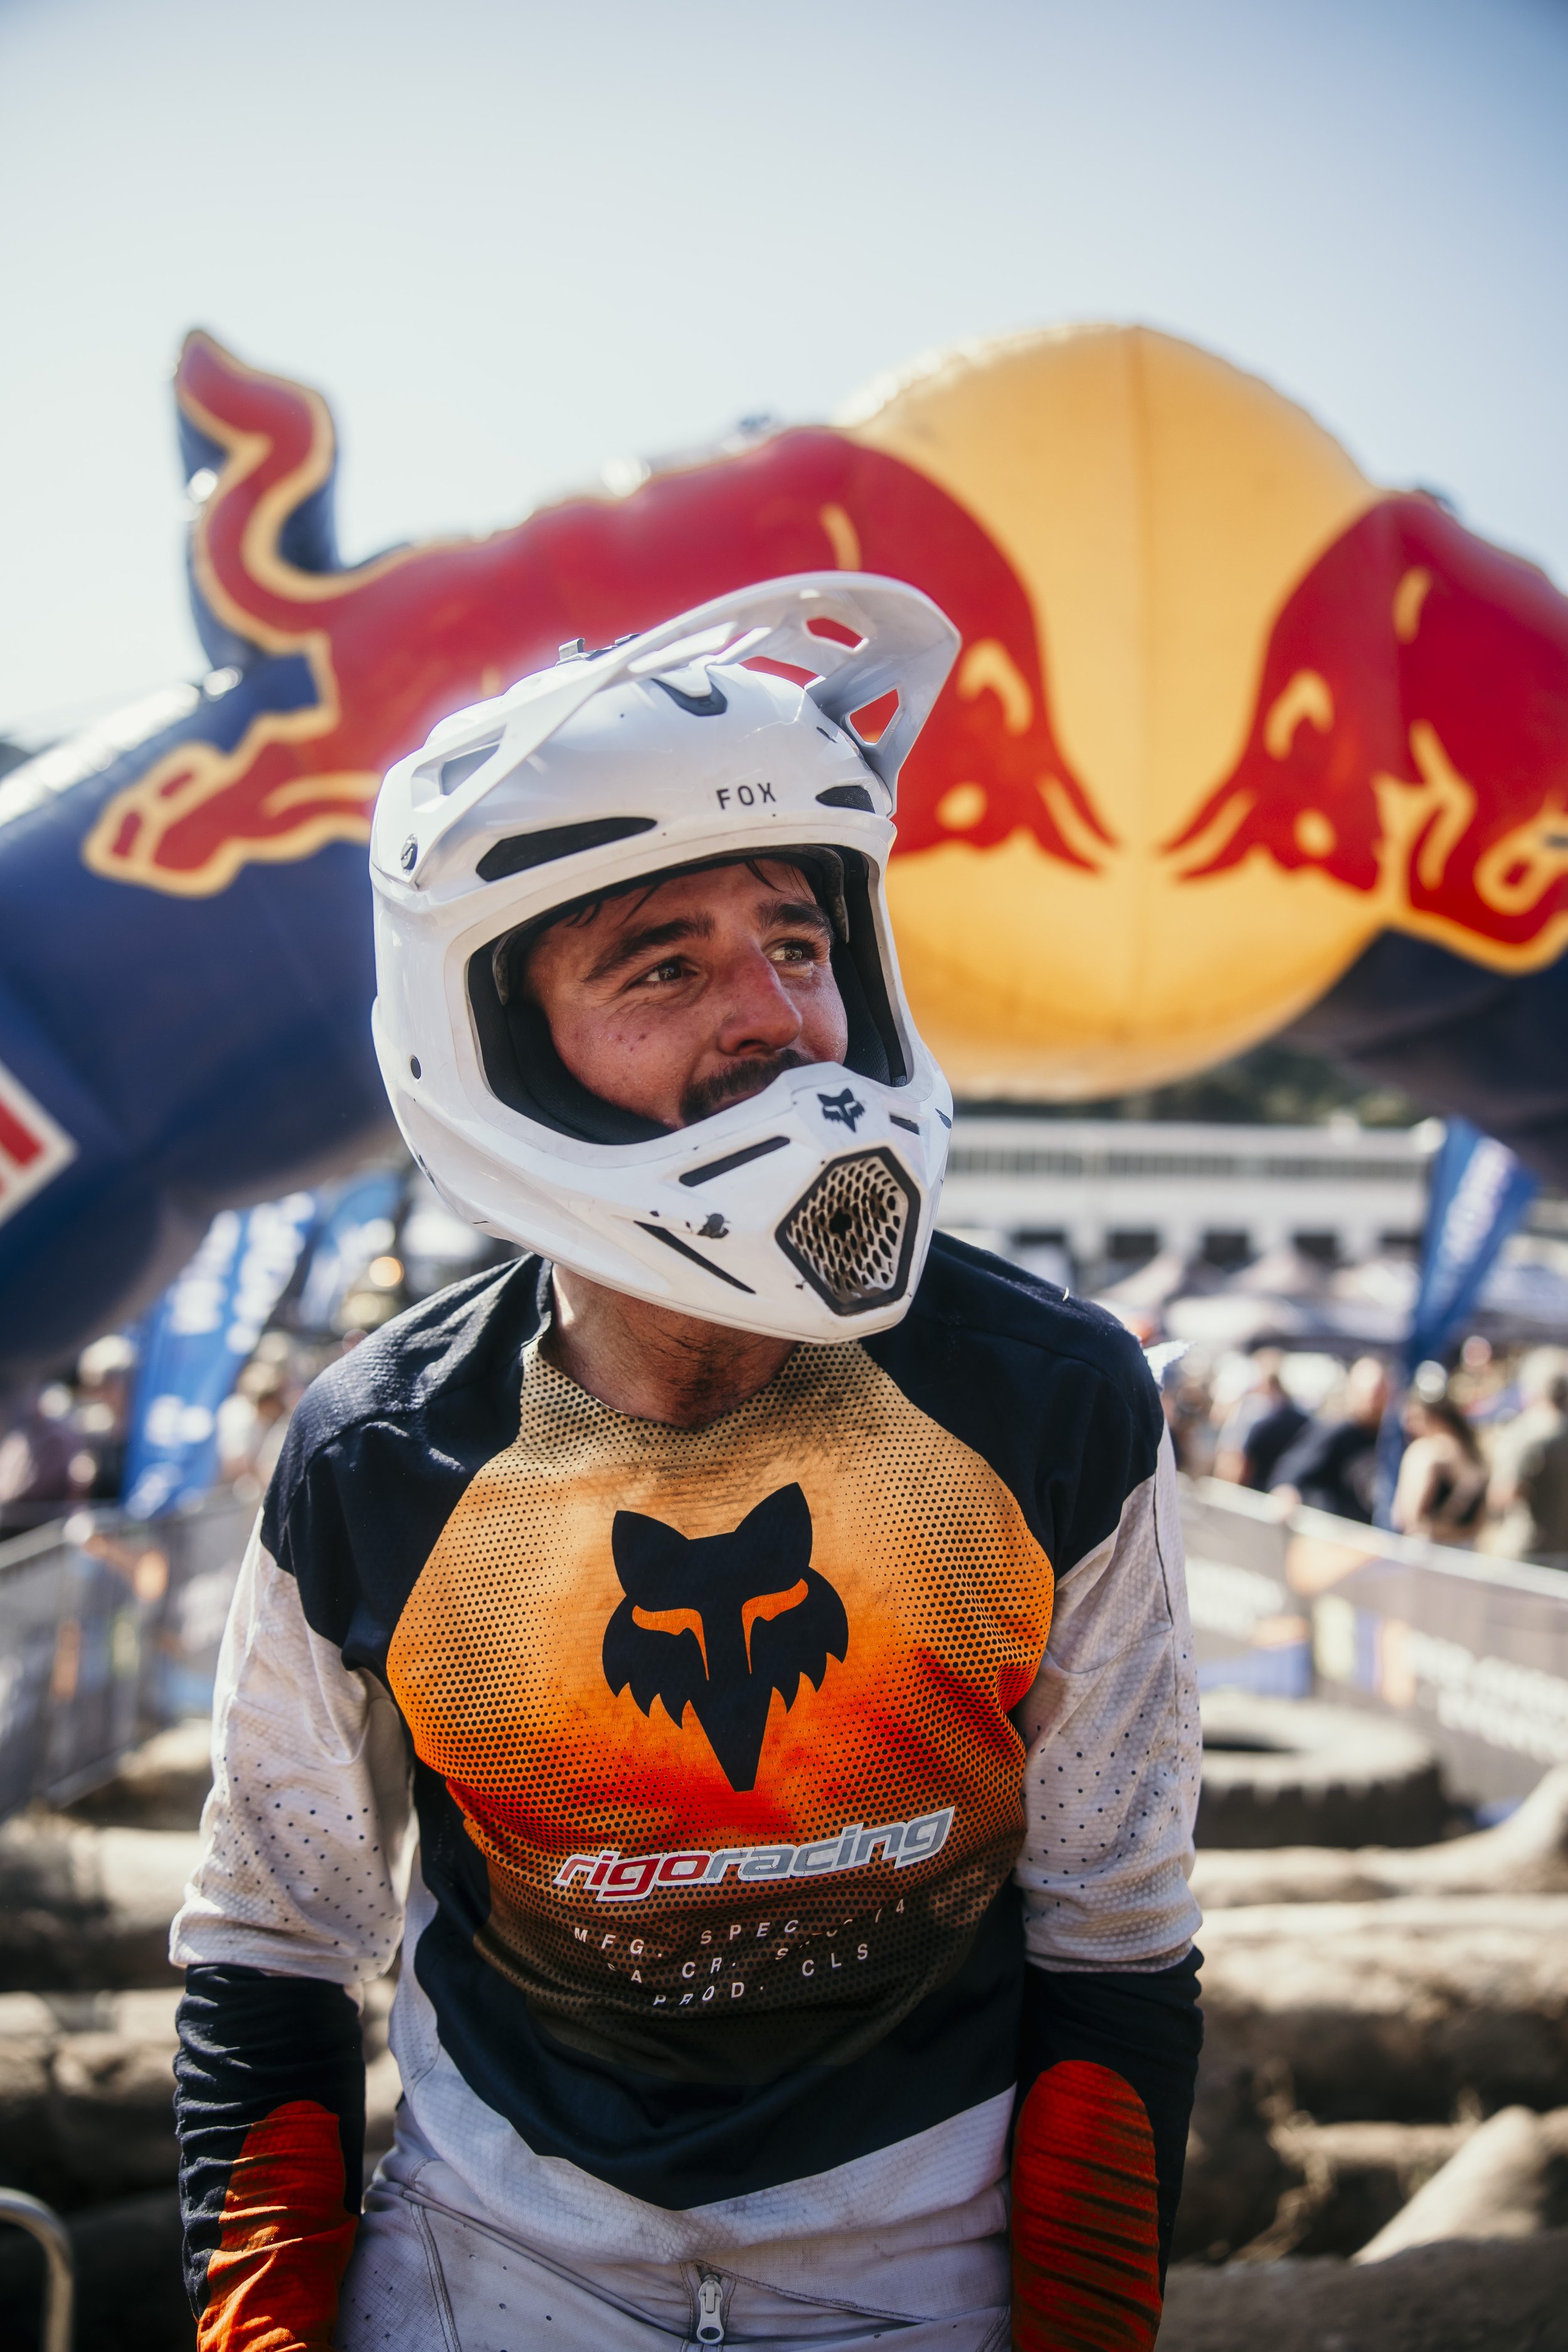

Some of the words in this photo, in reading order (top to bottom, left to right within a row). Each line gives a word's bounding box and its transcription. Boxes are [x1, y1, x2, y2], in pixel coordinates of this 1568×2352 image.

[716, 782, 776, 810] FOX
[554, 1807, 954, 1900] rigoracing
[574, 1927, 662, 1957] MFG.
